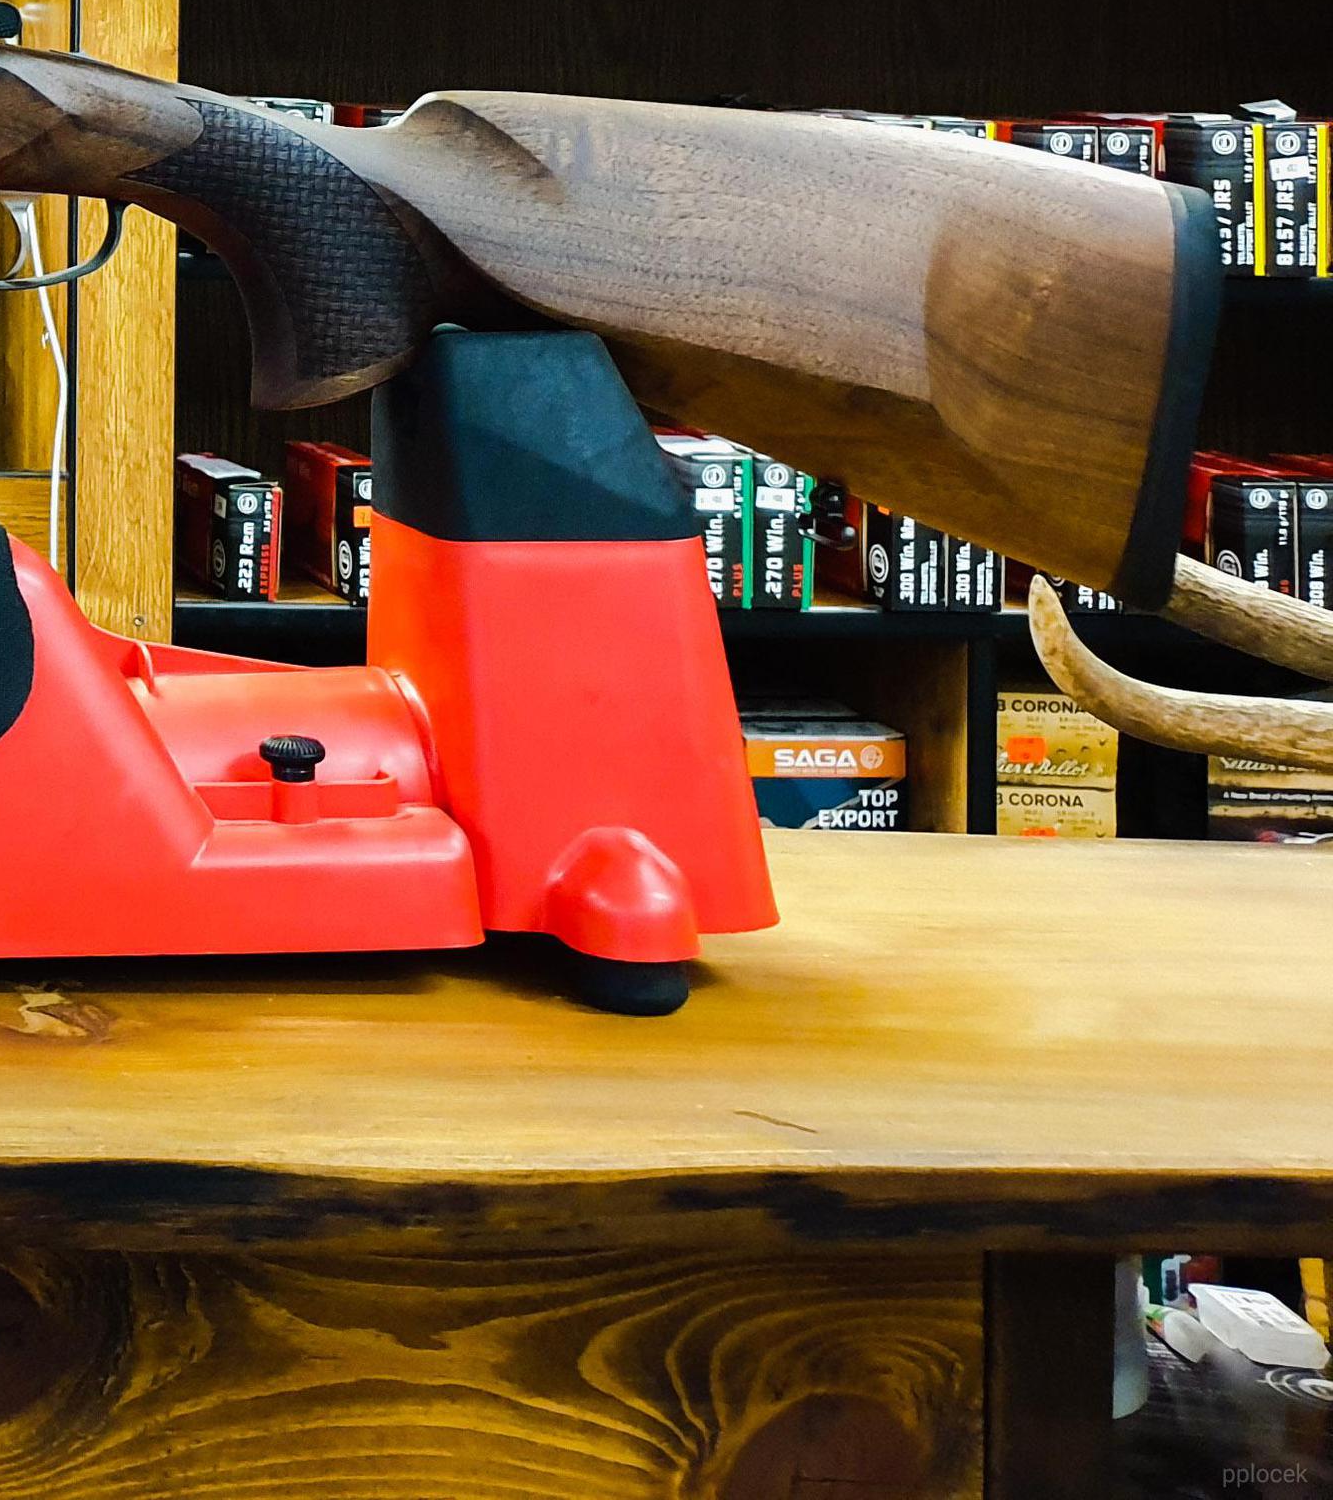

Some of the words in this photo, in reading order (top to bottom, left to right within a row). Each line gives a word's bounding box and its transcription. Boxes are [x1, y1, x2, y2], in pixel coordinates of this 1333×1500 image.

[1213, 179, 1232, 211] JRS
[1276, 180, 1295, 211] JRS
[1276, 216, 1295, 240] 57
[1276, 253, 1294, 266] 8
[1279, 241, 1294, 252] x
[239, 521, 255, 555] Rem
[705, 512, 724, 553] Win.
[765, 512, 784, 553] Win.
[259, 544, 270, 595] EXPRESS
[900, 541, 915, 571] Win.
[956, 541, 971, 572] Win.
[1253, 549, 1269, 578] Win.
[1309, 549, 1324, 579] Win.
[238, 558, 254, 594] .223
[732, 563, 743, 597] PLUS
[765, 557, 783, 600] .270
[792, 563, 804, 597] PLUS
[900, 572, 915, 604] 300
[956, 573, 971, 605] 300
[773, 748, 857, 768] SAGA
[1035, 757, 1089, 776] Bellot
[858, 789, 899, 808] TOP
[1009, 793, 1084, 808] CORONA
[818, 809, 899, 828] EXPORT
